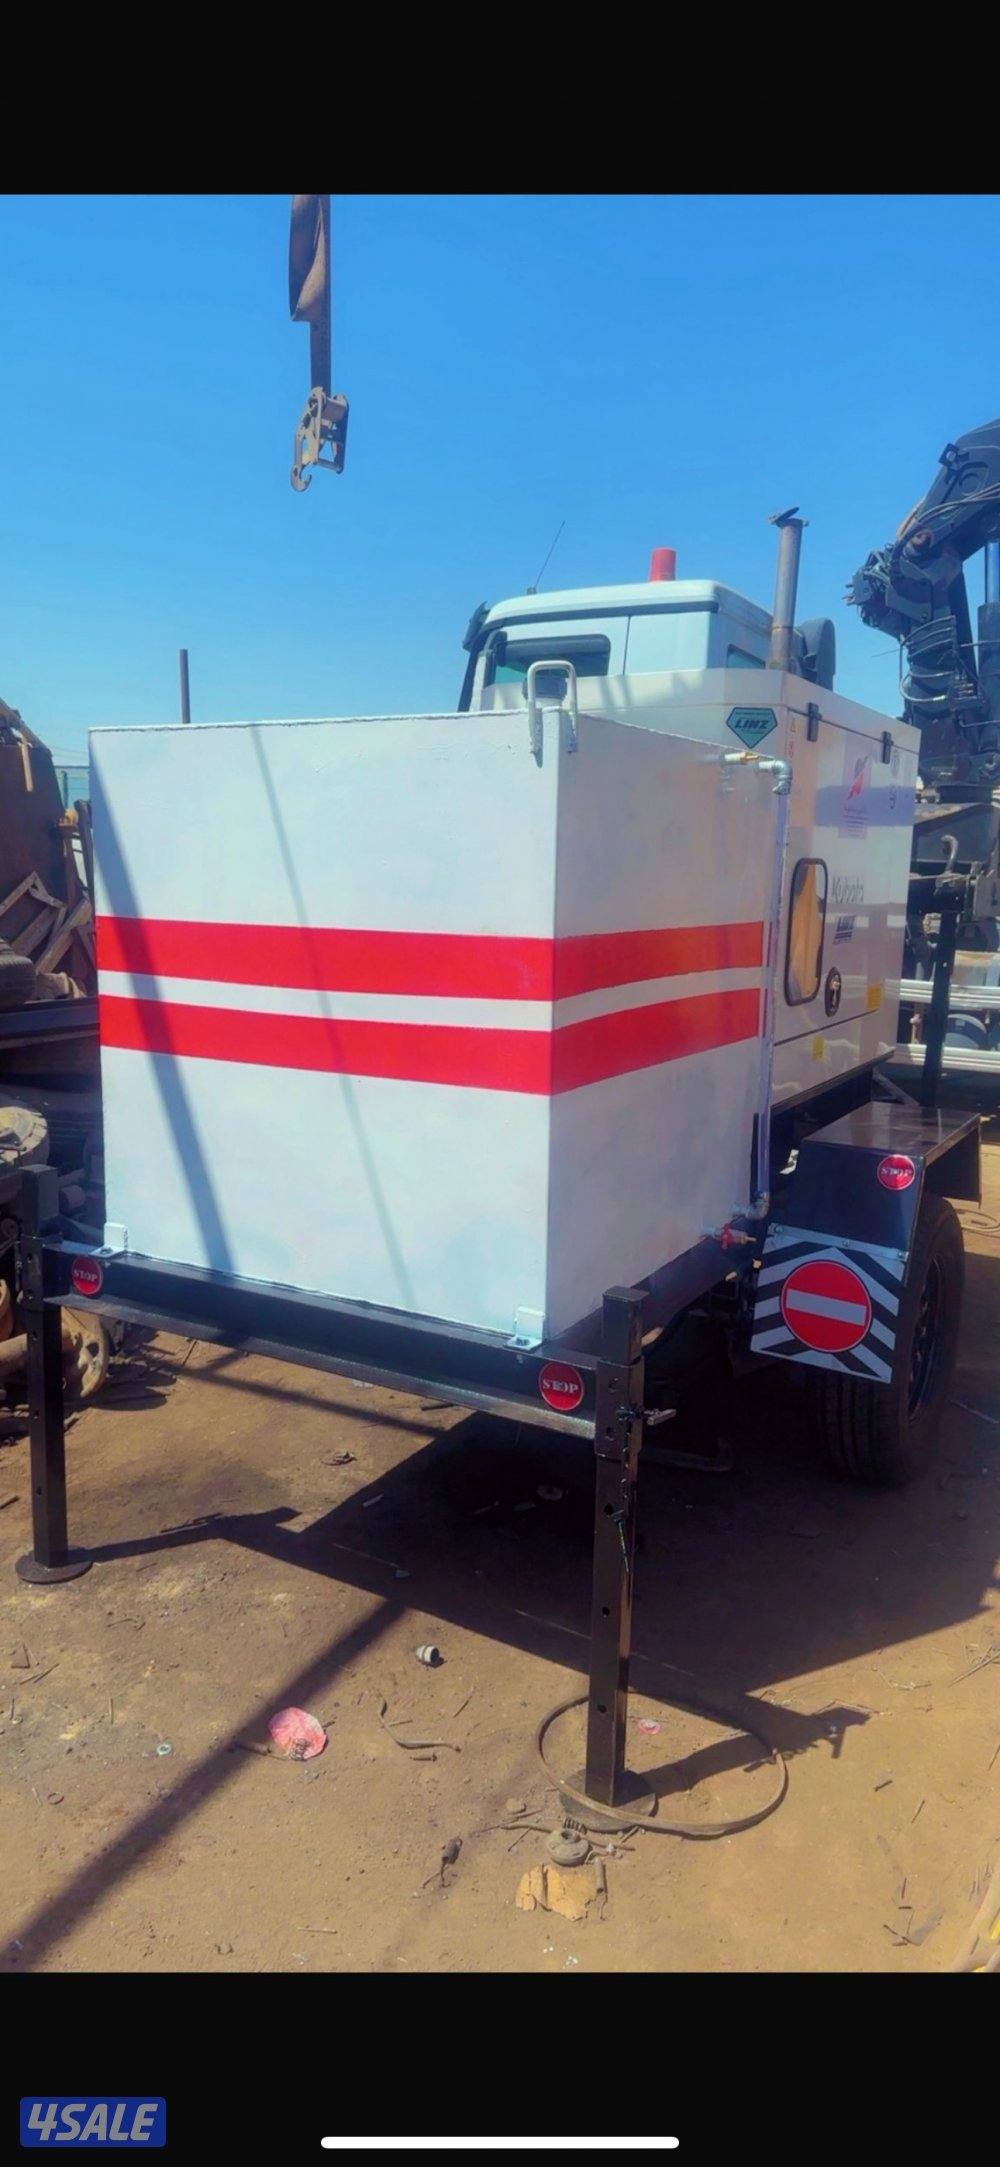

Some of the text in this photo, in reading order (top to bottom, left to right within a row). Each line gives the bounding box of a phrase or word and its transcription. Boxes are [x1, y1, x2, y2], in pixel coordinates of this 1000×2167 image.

[881, 1167, 912, 1177] STOP
[73, 1269, 98, 1281] STOP
[542, 1378, 579, 1394] STOP
